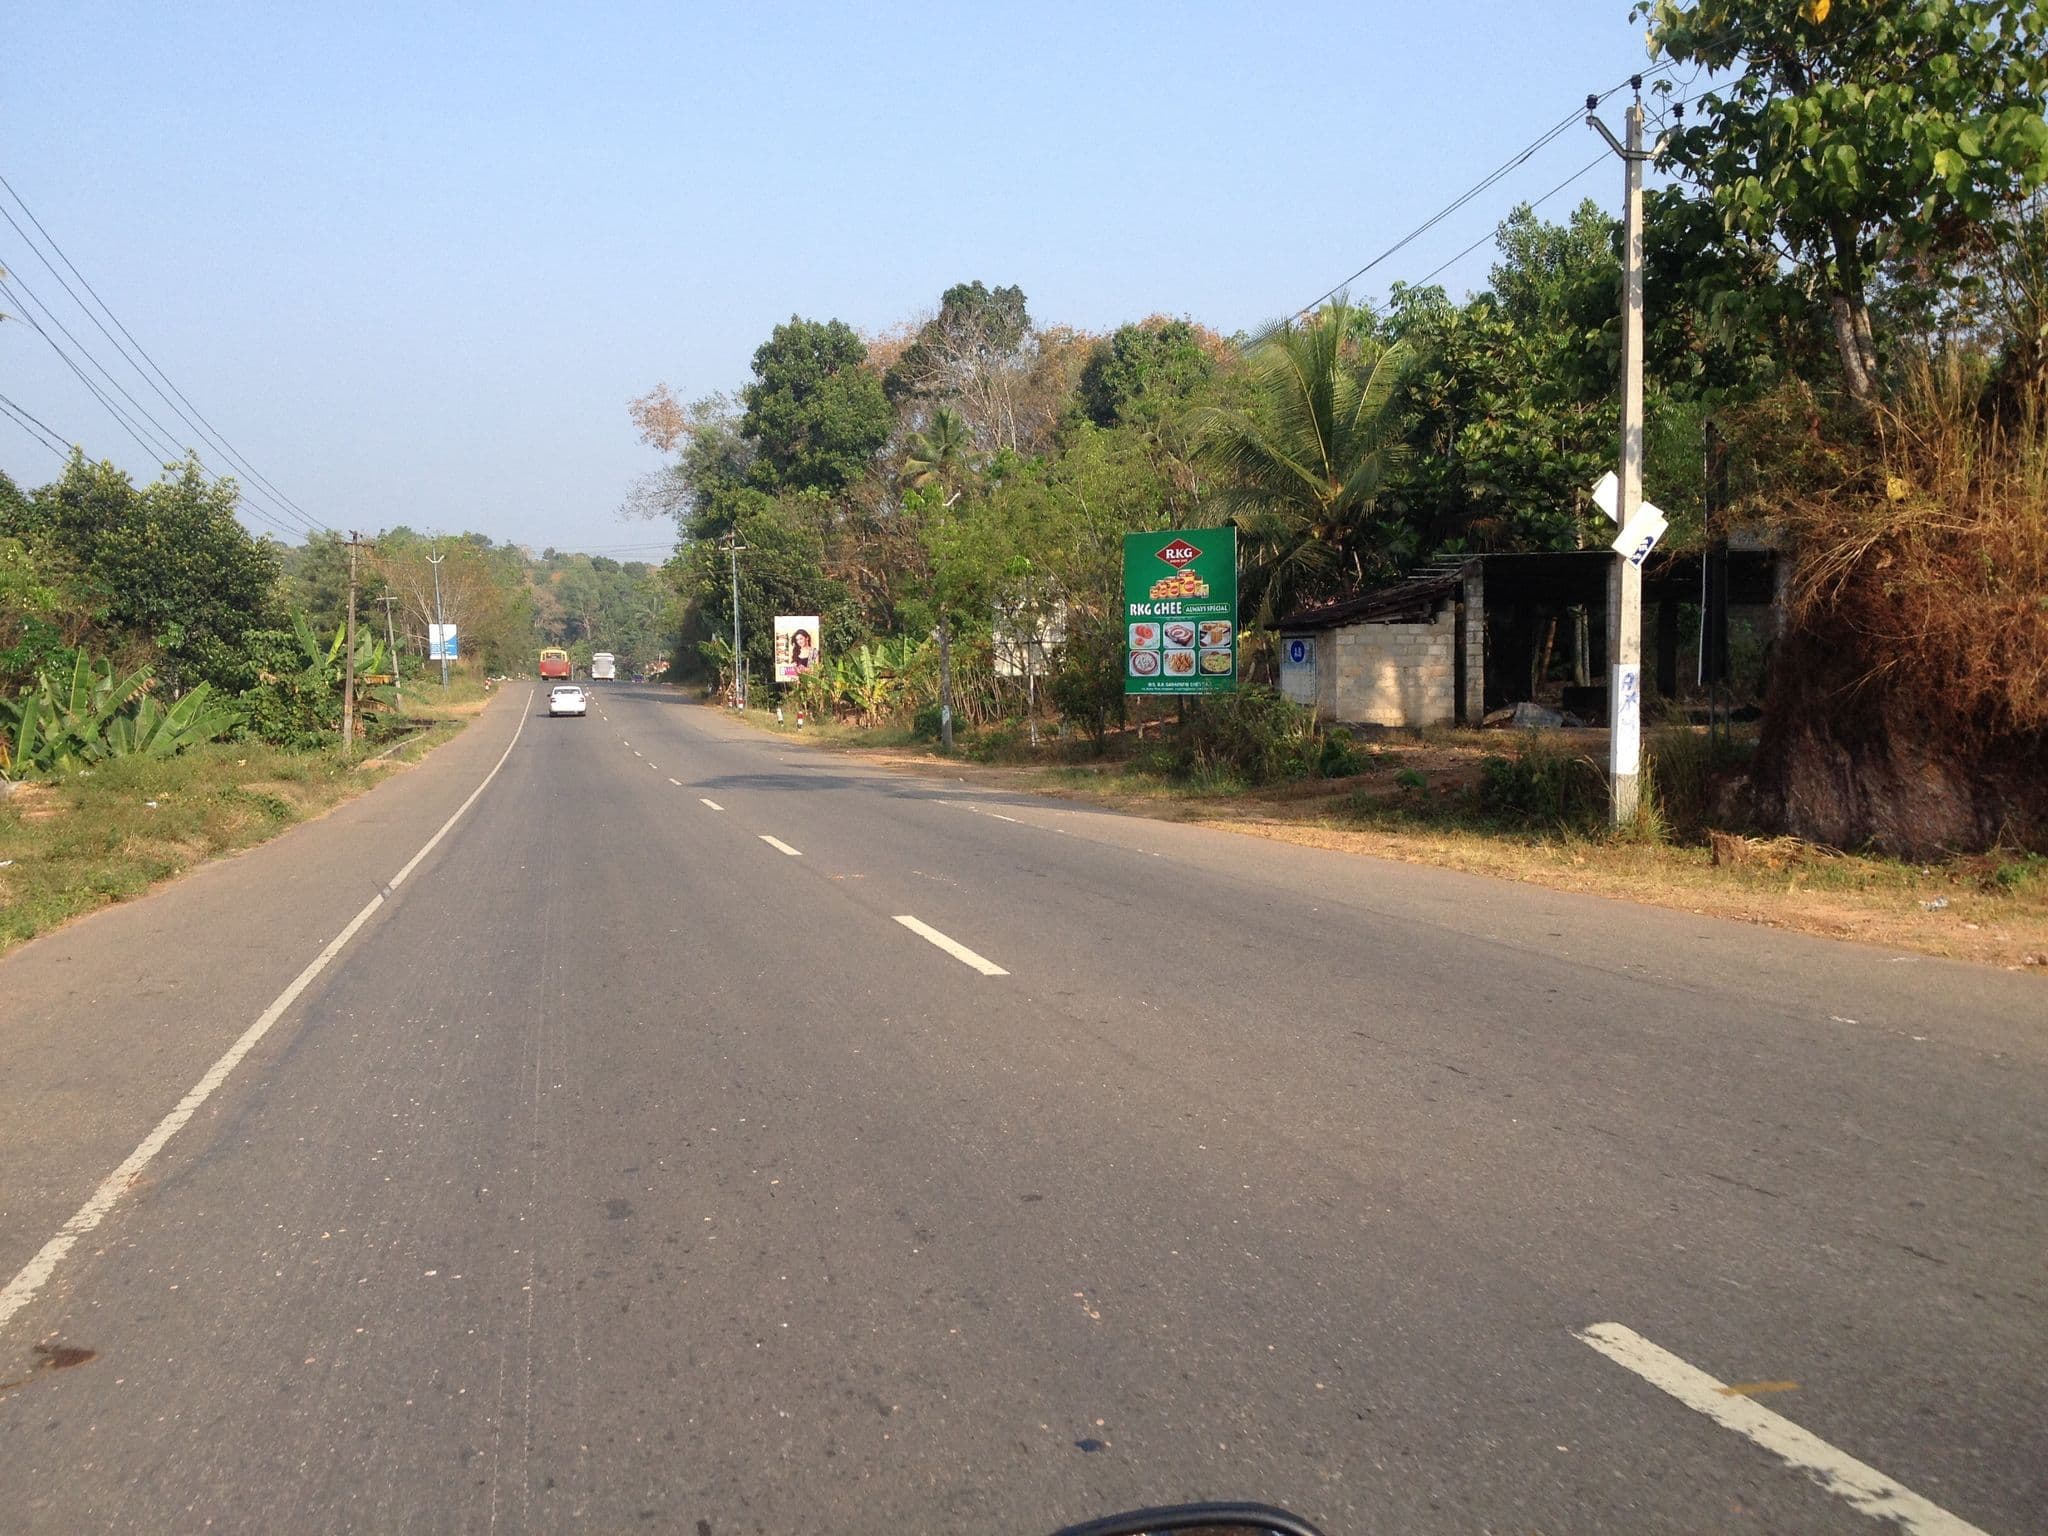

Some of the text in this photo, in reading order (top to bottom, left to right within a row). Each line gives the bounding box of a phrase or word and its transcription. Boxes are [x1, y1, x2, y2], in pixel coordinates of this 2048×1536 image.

[1130, 602, 1182, 616] RKG GHEE
[1185, 604, 1228, 613] ALWAYS SPECIAL
